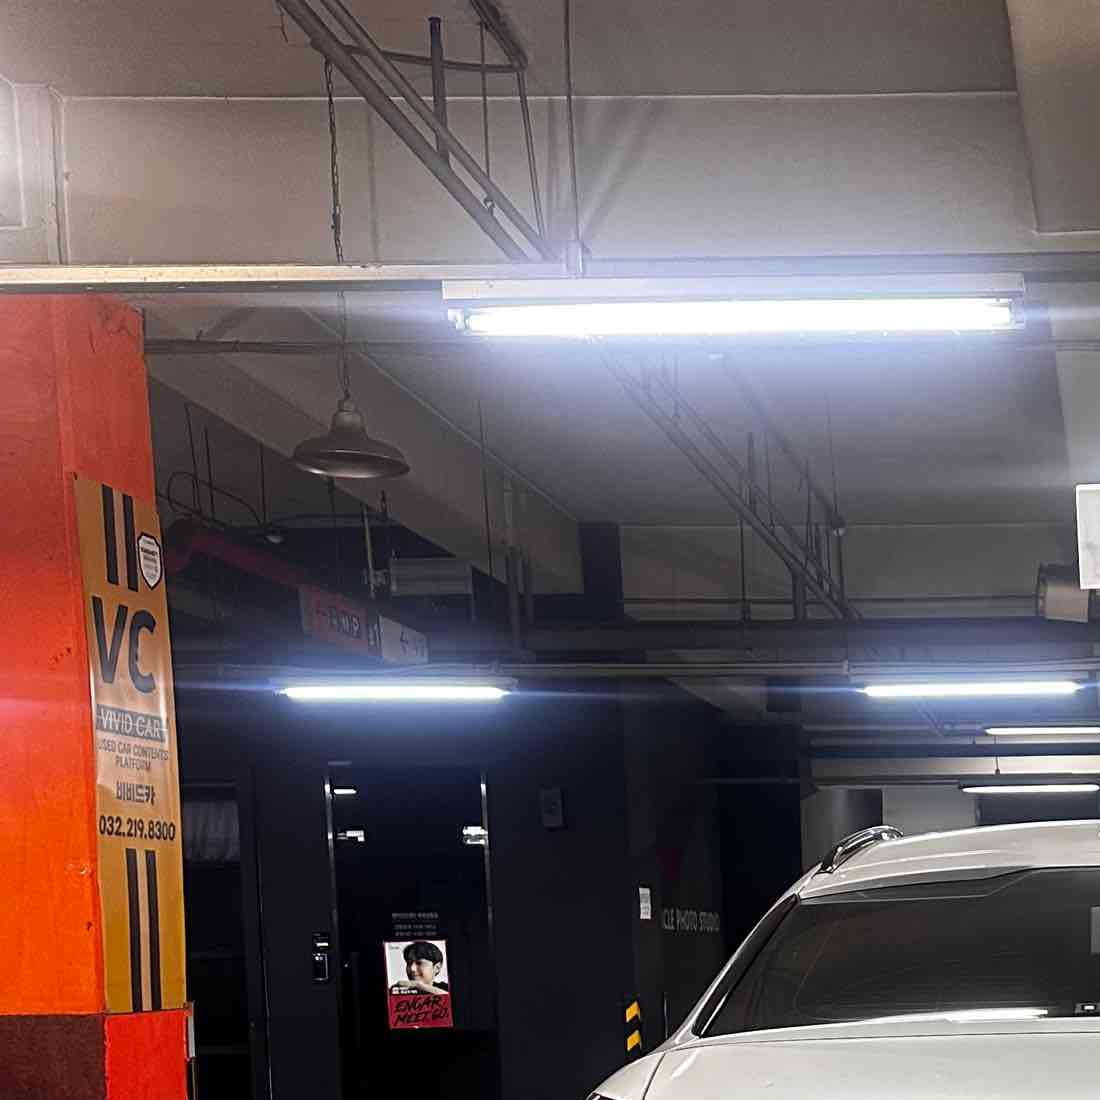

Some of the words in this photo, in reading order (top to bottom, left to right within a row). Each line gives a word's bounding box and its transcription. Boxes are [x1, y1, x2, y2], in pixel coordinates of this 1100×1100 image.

[91, 596, 157, 694] VC
[100, 708, 133, 734] VIVID
[135, 714, 162, 738] CAR
[116, 781, 156, 806] 비비드카
[99, 815, 176, 840] 032.219.8300
